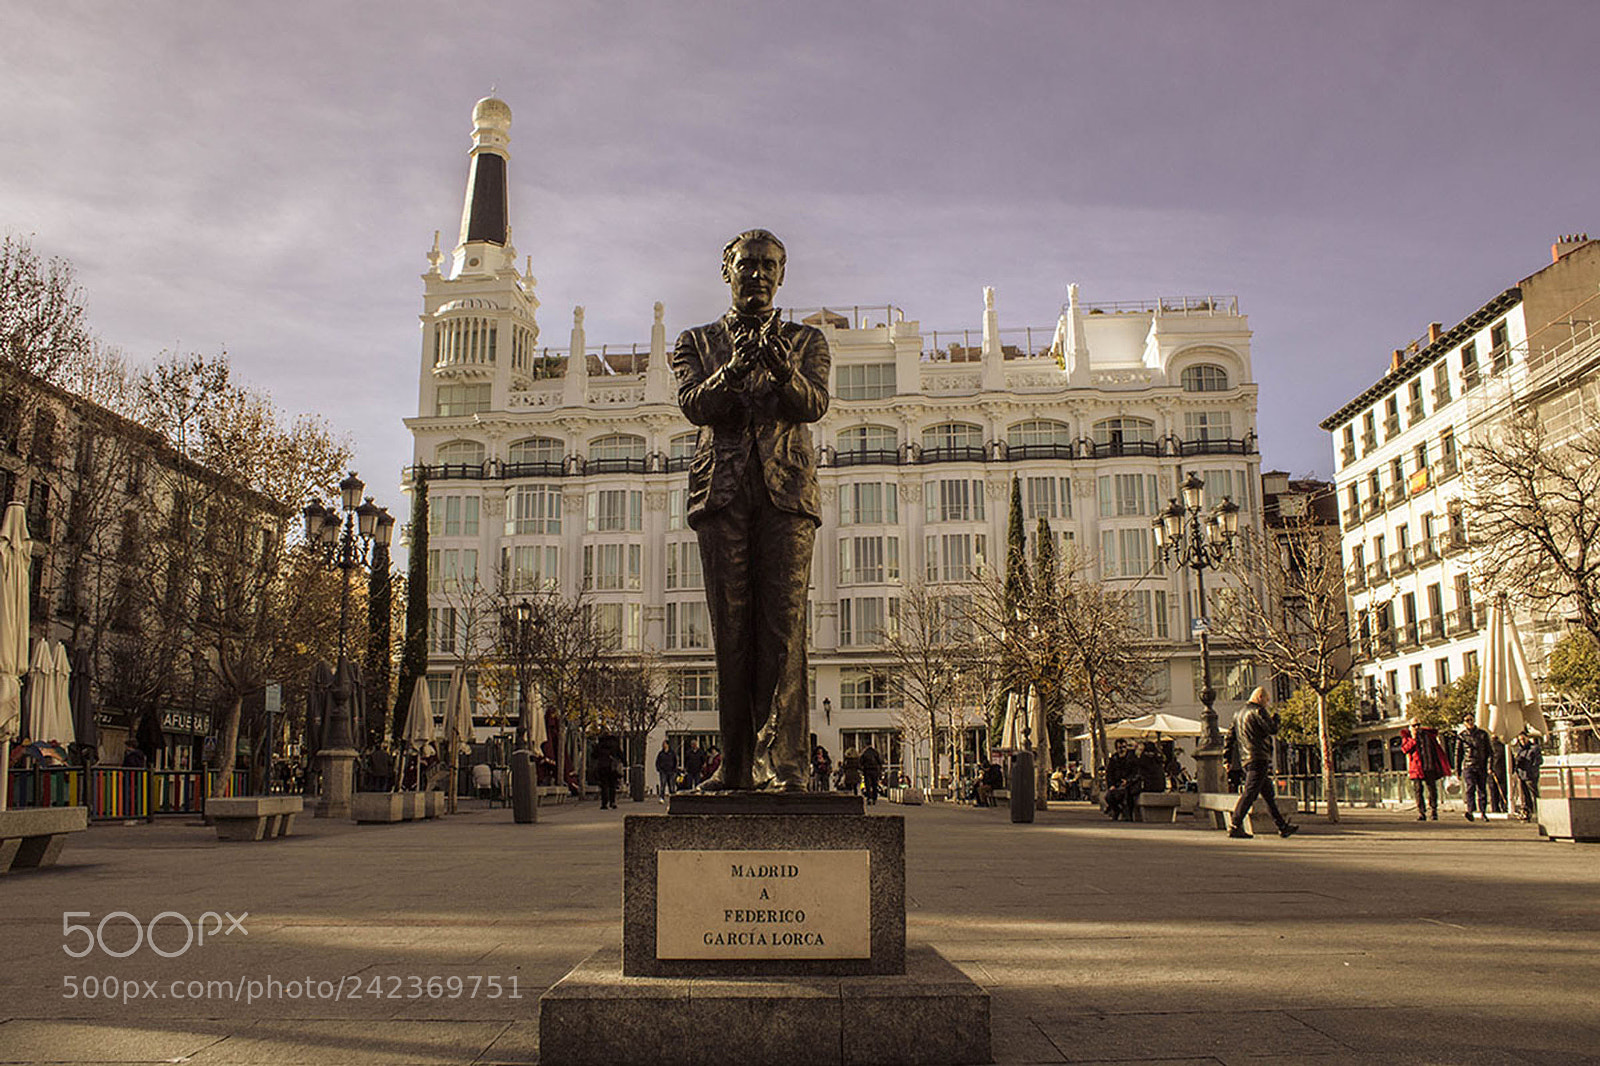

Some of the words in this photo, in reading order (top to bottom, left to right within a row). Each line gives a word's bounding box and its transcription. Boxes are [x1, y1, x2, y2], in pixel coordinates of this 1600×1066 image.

[731, 864, 799, 878] MADRID
[759, 887, 770, 900] A
[724, 909, 806, 923] FEDERICO
[703, 927, 767, 946] GARCÍA
[772, 932, 825, 946] LORCA
